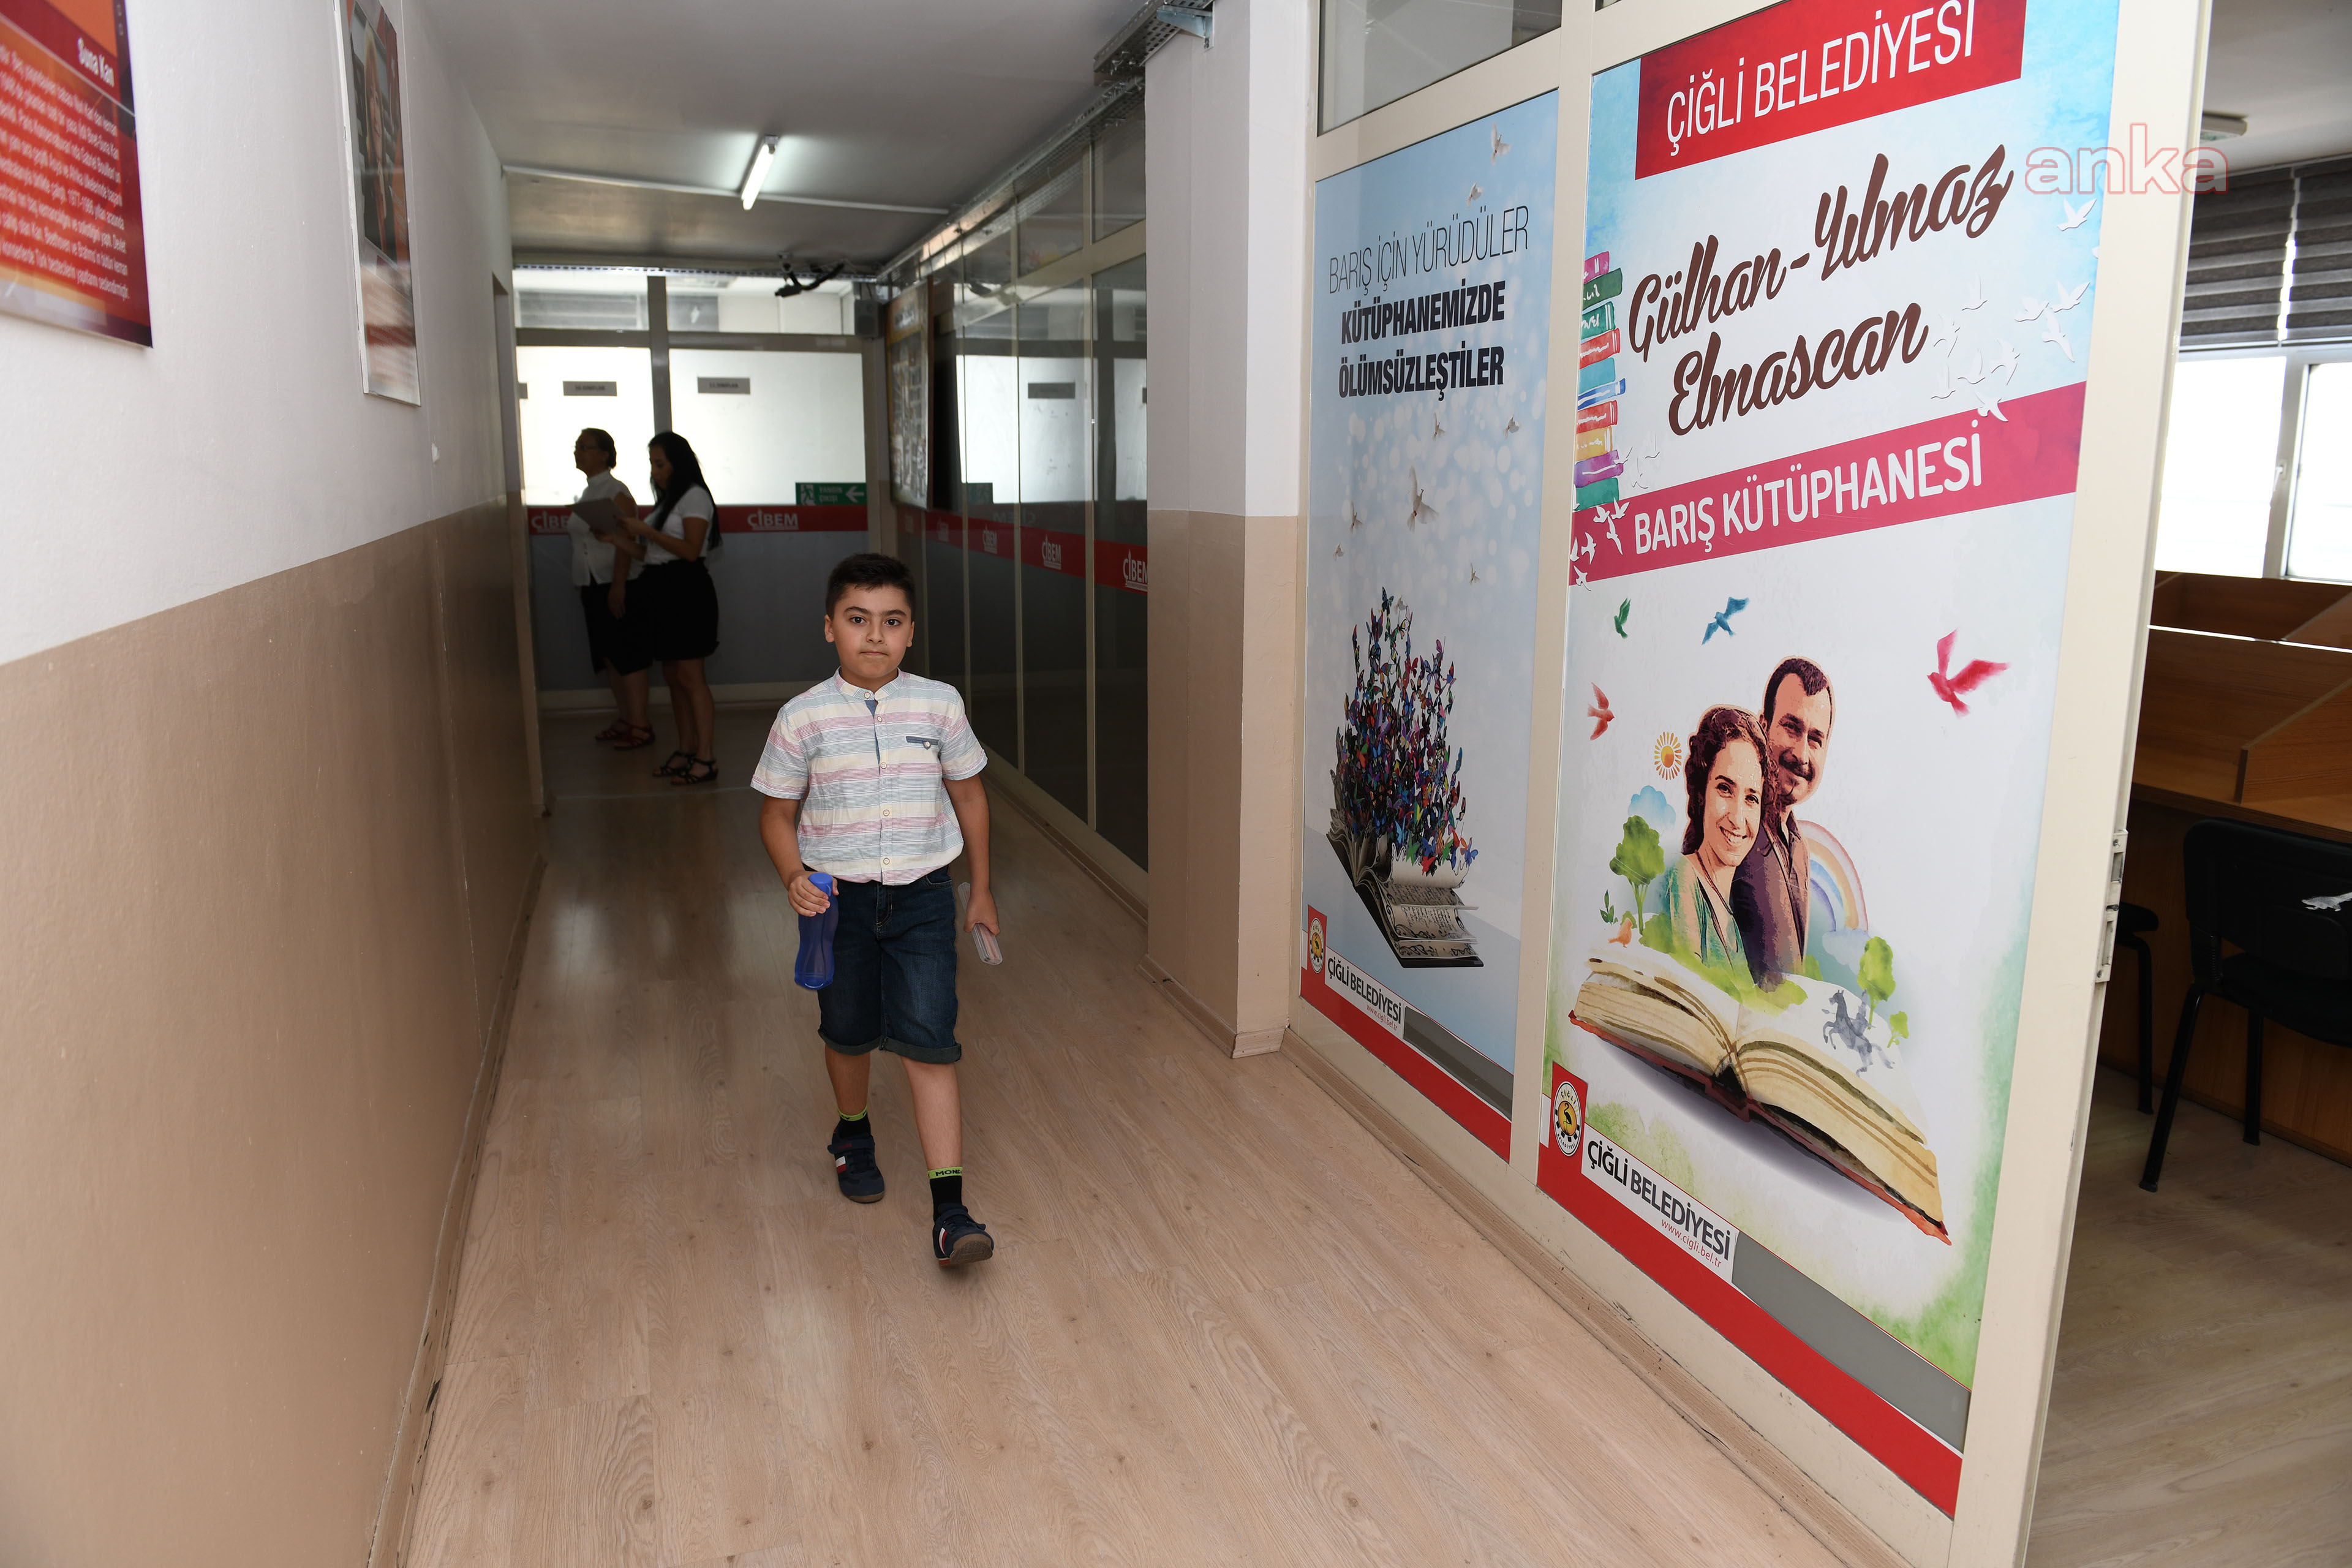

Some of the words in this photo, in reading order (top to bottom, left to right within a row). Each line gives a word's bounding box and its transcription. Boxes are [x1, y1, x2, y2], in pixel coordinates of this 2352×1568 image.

[1667, 57, 1745, 156] ÇİĞLİ
[1329, 247, 1372, 296] BARIŞ
[1377, 231, 1408, 292] İÇİN
[1412, 205, 1529, 274] YÜRÜDÜLER
[1341, 278, 1506, 344] KÜTÜPHANEMİZDE
[1338, 341, 1504, 401] ÖLÜMSÜZLEŞTİLER
[1669, 303, 1929, 436] Elmascan
[1635, 497, 1715, 552] BARIŞ
[1722, 420, 1982, 537] KÜTÜPHANESİ
[1327, 957, 1349, 986] ÇİĞLİ
[1350, 972, 1401, 1024] BELEDİYESİ
[1366, 1005, 1398, 1031] www.cigli.bel.tr
[1588, 1140, 1628, 1186] ÇİĞLİ
[1630, 1169, 1730, 1261] BELEDİYESİ
[1662, 1219, 1722, 1268] www.cigli.bel.tr
